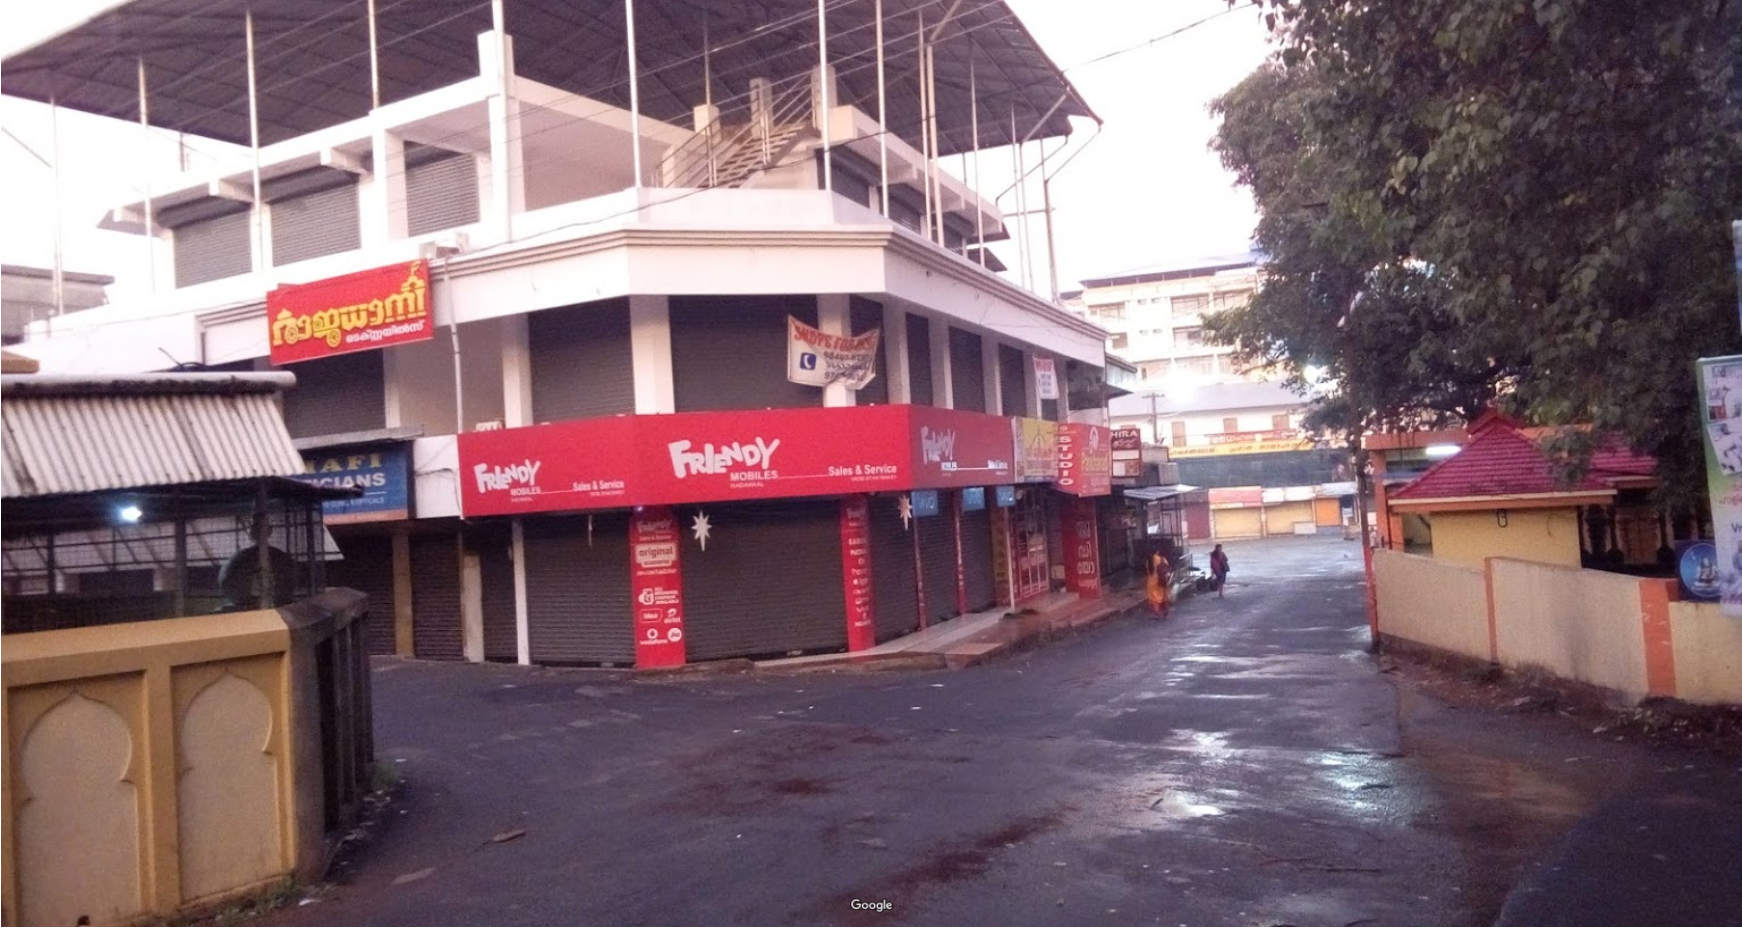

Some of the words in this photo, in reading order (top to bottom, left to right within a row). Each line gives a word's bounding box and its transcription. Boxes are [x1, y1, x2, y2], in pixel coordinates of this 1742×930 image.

[667, 436, 780, 479] FRIENDY
[1059, 435, 1074, 486] STUDIO
[473, 458, 541, 494] FRIENDY
[730, 470, 779, 482] MOBILES
[828, 465, 853, 477] Sales
[855, 464, 861, 475] &
[864, 463, 898, 475] Service
[573, 481, 591, 492] Sales
[592, 480, 599, 491] &
[600, 480, 625, 490] Service
[638, 546, 674, 559] original
